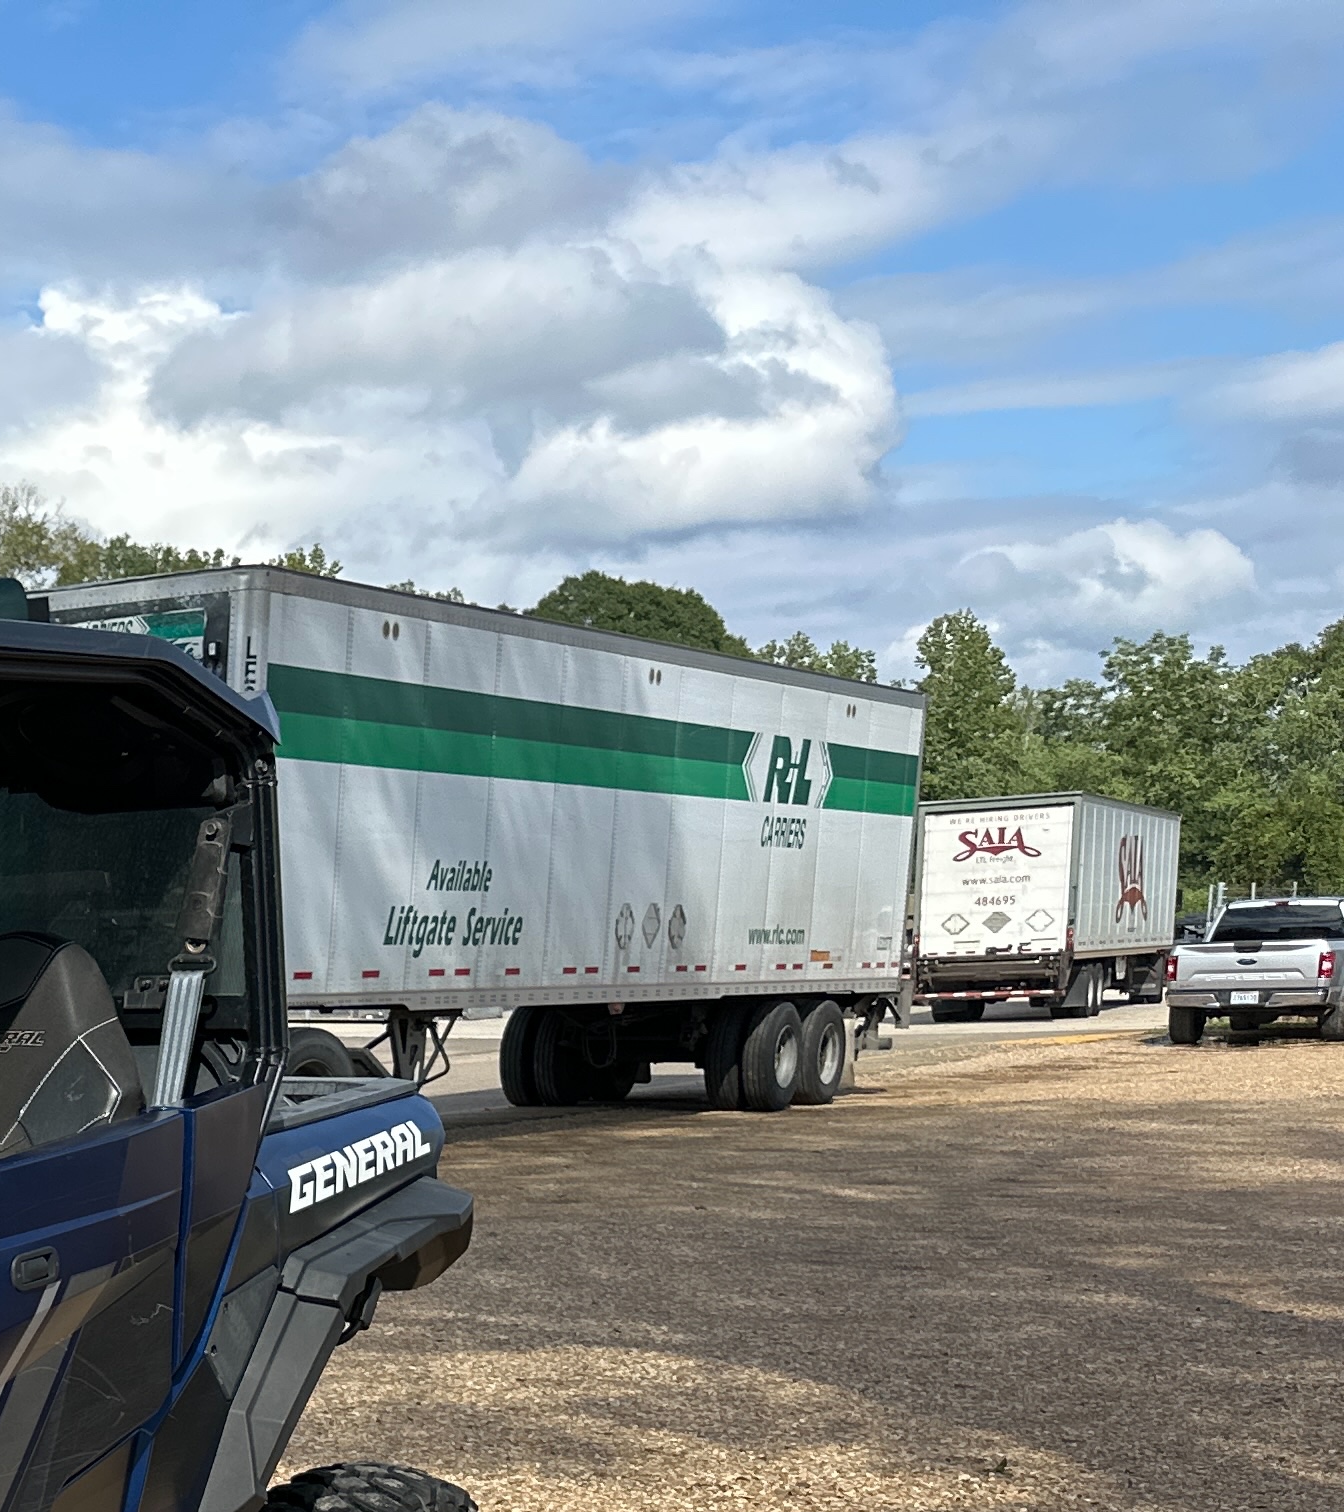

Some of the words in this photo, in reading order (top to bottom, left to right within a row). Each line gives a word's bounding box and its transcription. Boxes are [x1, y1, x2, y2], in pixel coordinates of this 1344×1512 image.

[761, 815, 807, 850] CARRIERS
[1014, 812, 1050, 822] DRIVERS
[953, 826, 1042, 862] SAIA
[425, 859, 493, 892] Available
[962, 875, 1031, 886] www.saia.com
[974, 895, 1016, 907] 484695
[383, 905, 457, 958] Liftgate
[462, 907, 523, 946] Service
[748, 923, 806, 945] www.rlc.com
[287, 1120, 431, 1214] GENERAL
